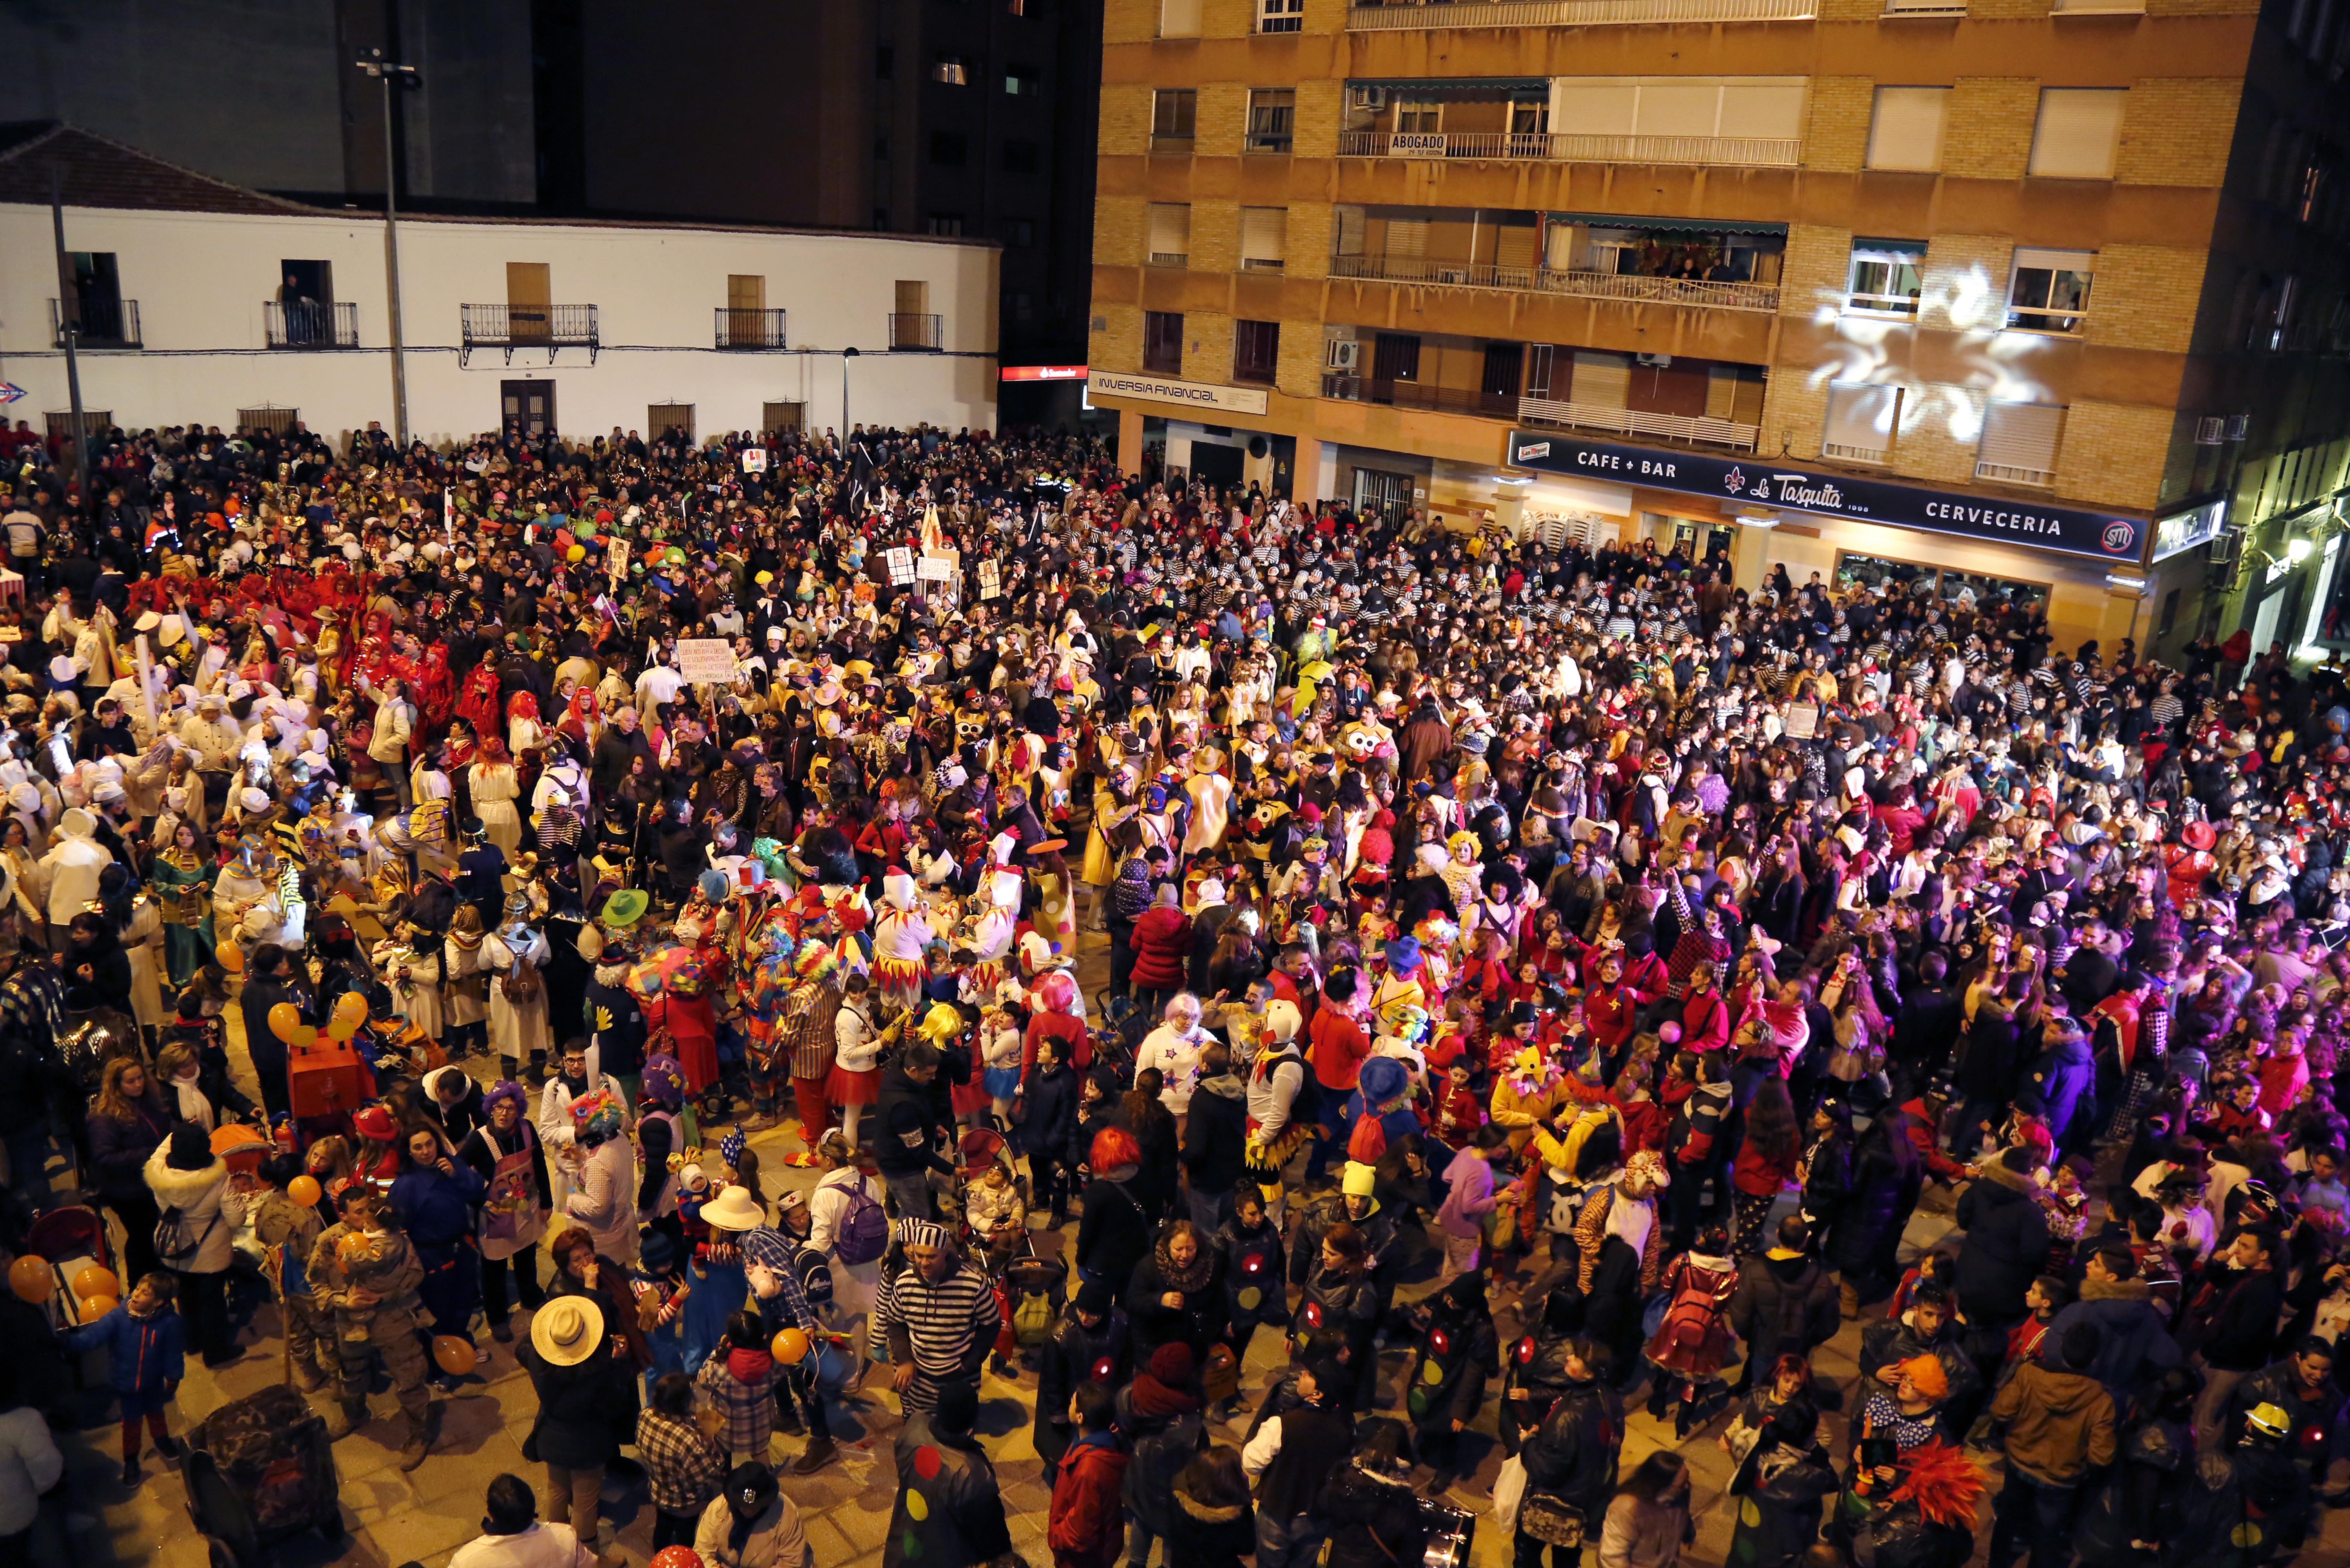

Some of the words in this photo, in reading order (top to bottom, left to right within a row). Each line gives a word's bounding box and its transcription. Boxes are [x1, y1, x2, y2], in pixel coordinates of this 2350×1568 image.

[1392, 136, 1443, 148] ABOGADO
[1048, 368, 1076, 377] Santander
[1099, 378, 1153, 393] INVERSIA
[1531, 446, 1547, 455] Miguel
[1577, 452, 1620, 470] CAFE
[1641, 461, 1676, 478] BAR
[1750, 478, 1770, 498] La
[1773, 474, 1842, 508] Tasquita
[1926, 502, 2061, 535] CERVECERIA
